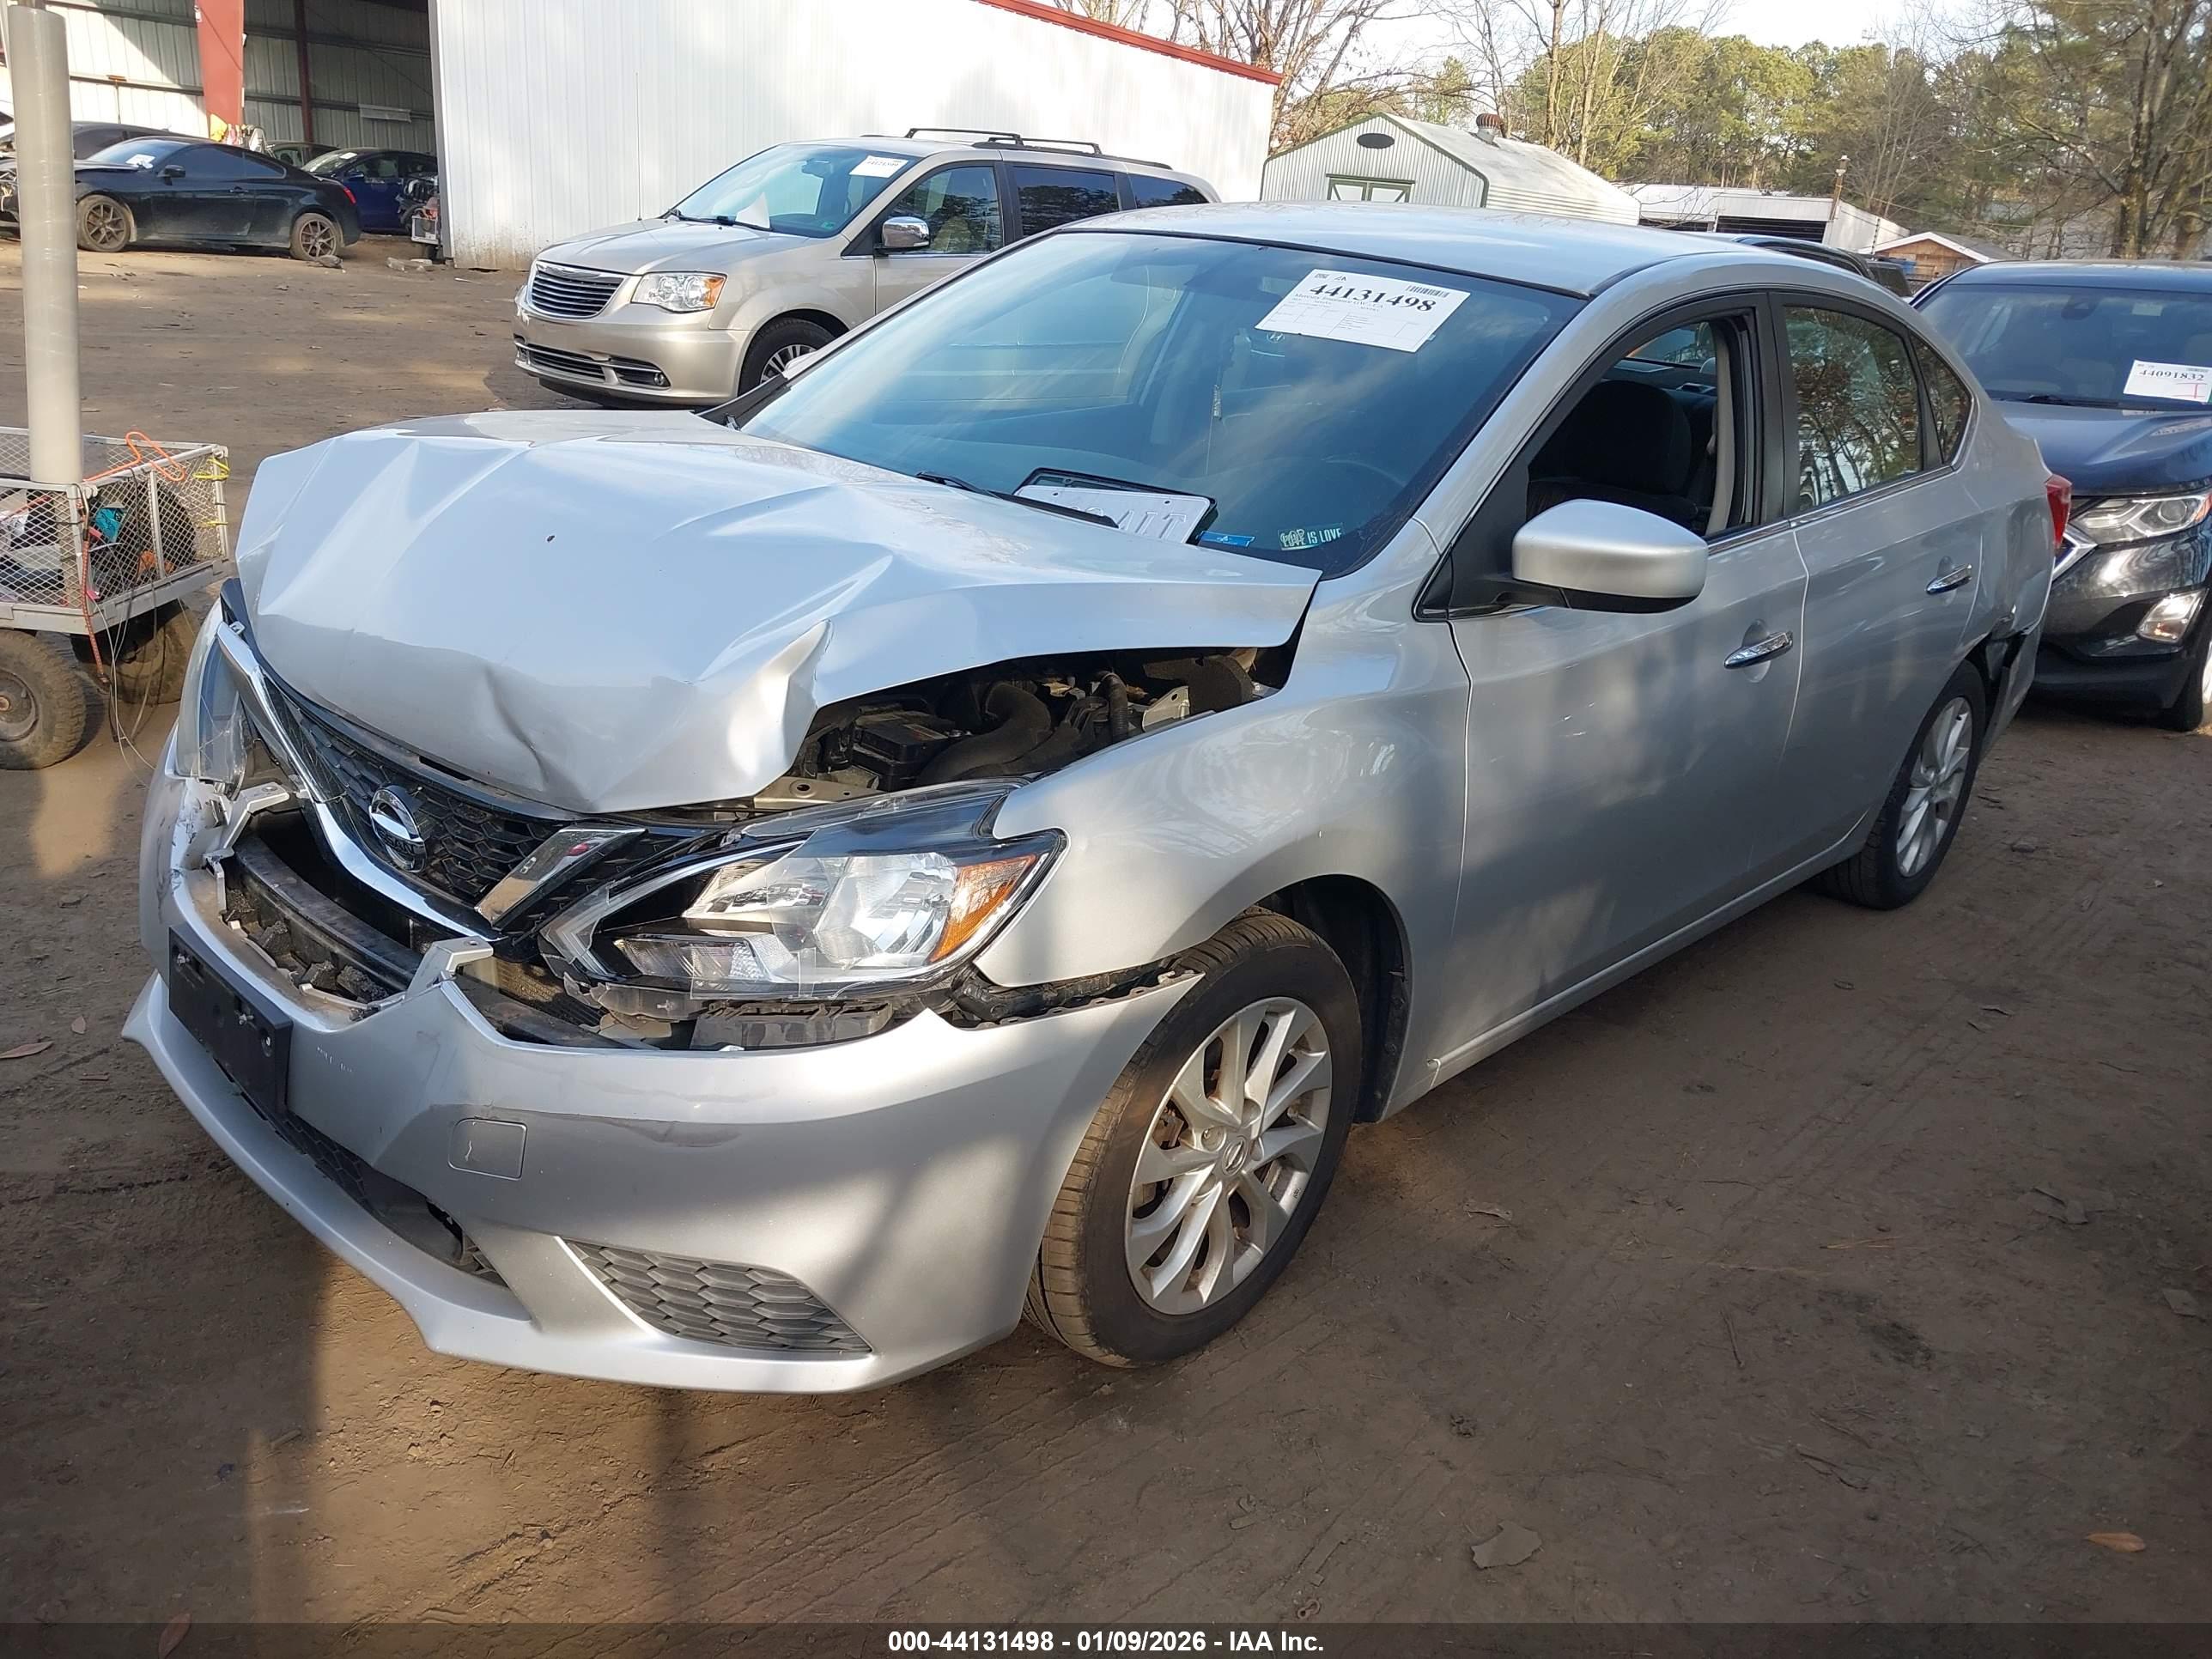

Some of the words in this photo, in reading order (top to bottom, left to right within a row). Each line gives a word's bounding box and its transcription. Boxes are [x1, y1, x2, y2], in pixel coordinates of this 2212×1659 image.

[1310, 283, 1437, 312] 44131498
[2138, 369, 2205, 381] 44091832
[1307, 531, 1318, 544] IS
